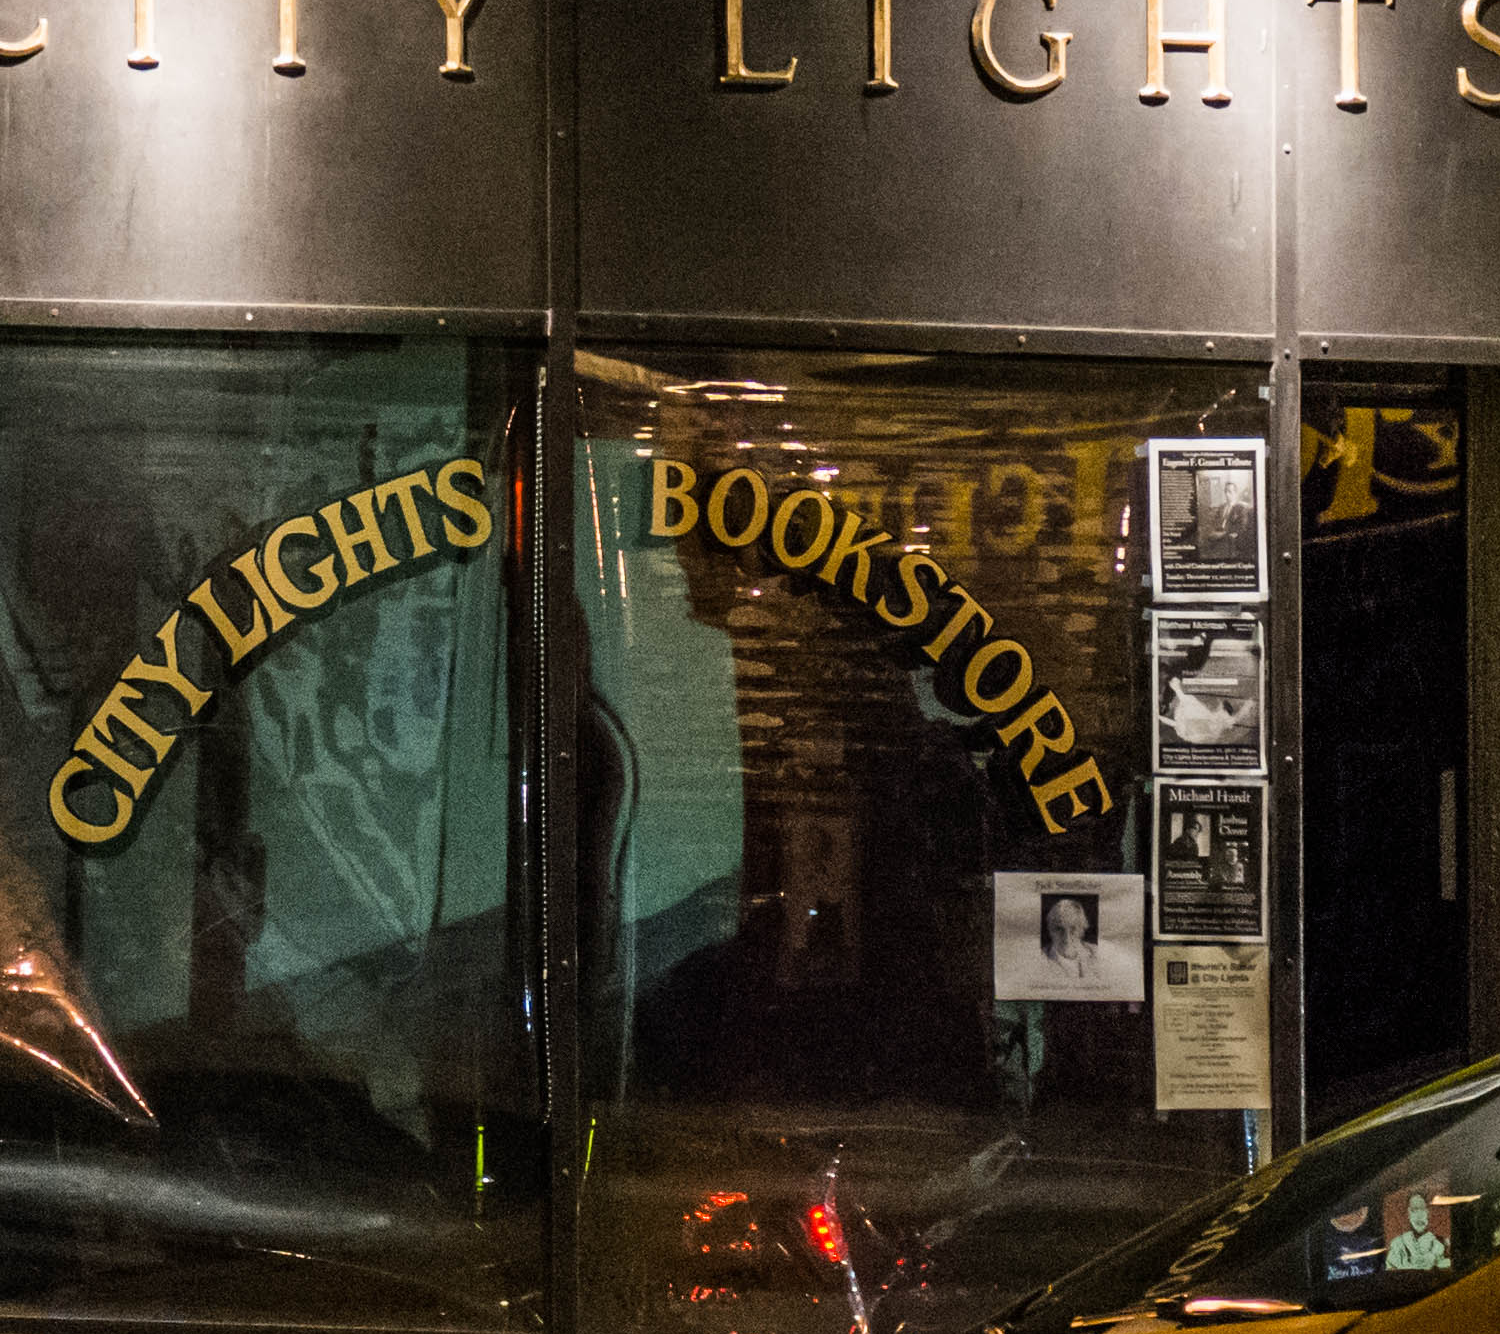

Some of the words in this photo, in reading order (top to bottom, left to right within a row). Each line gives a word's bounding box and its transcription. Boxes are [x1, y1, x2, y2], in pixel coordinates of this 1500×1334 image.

[48, 610, 213, 843] CITY
[187, 459, 493, 666] LIGHTS
[648, 458, 1114, 835] BOOKSTORE
[1169, 788, 1214, 803] Michael
[1217, 790, 1252, 803] Hardt
